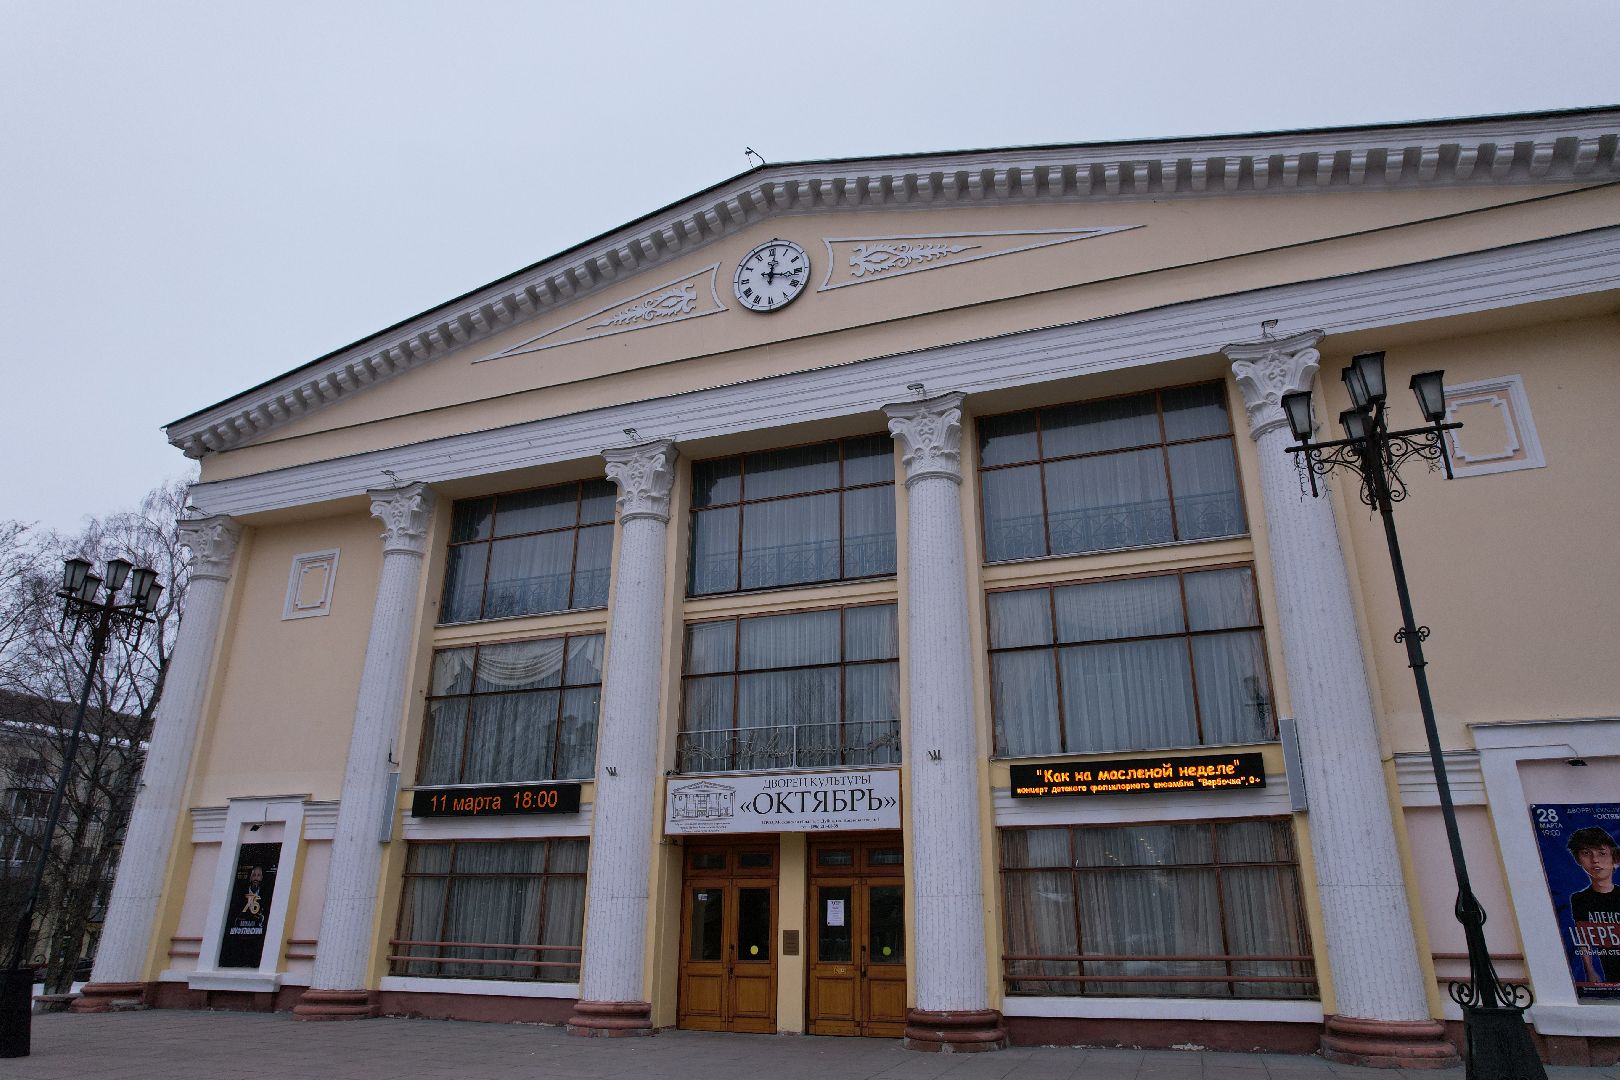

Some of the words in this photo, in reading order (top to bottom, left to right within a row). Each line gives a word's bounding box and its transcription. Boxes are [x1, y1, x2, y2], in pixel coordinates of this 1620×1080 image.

[1036, 769, 1069, 783] "Как
[1075, 771, 1092, 781] на
[1098, 763, 1173, 780] масленой
[1179, 759, 1240, 777] неделе"
[763, 777, 807, 790] ДВОРЕЦ
[810, 775, 871, 788] КУЛЬТУРЫ
[1016, 786, 1048, 795] концерт
[431, 794, 446, 811] 11
[453, 795, 501, 814] марта
[513, 790, 558, 808] 18:00
[740, 788, 897, 815] «ОКТЯБРЬ»
[1536, 809, 1559, 822] 28
[1569, 926, 1620, 950] ЩЕРБ
[1574, 948, 1607, 956] СОЛЬНЫЙ
